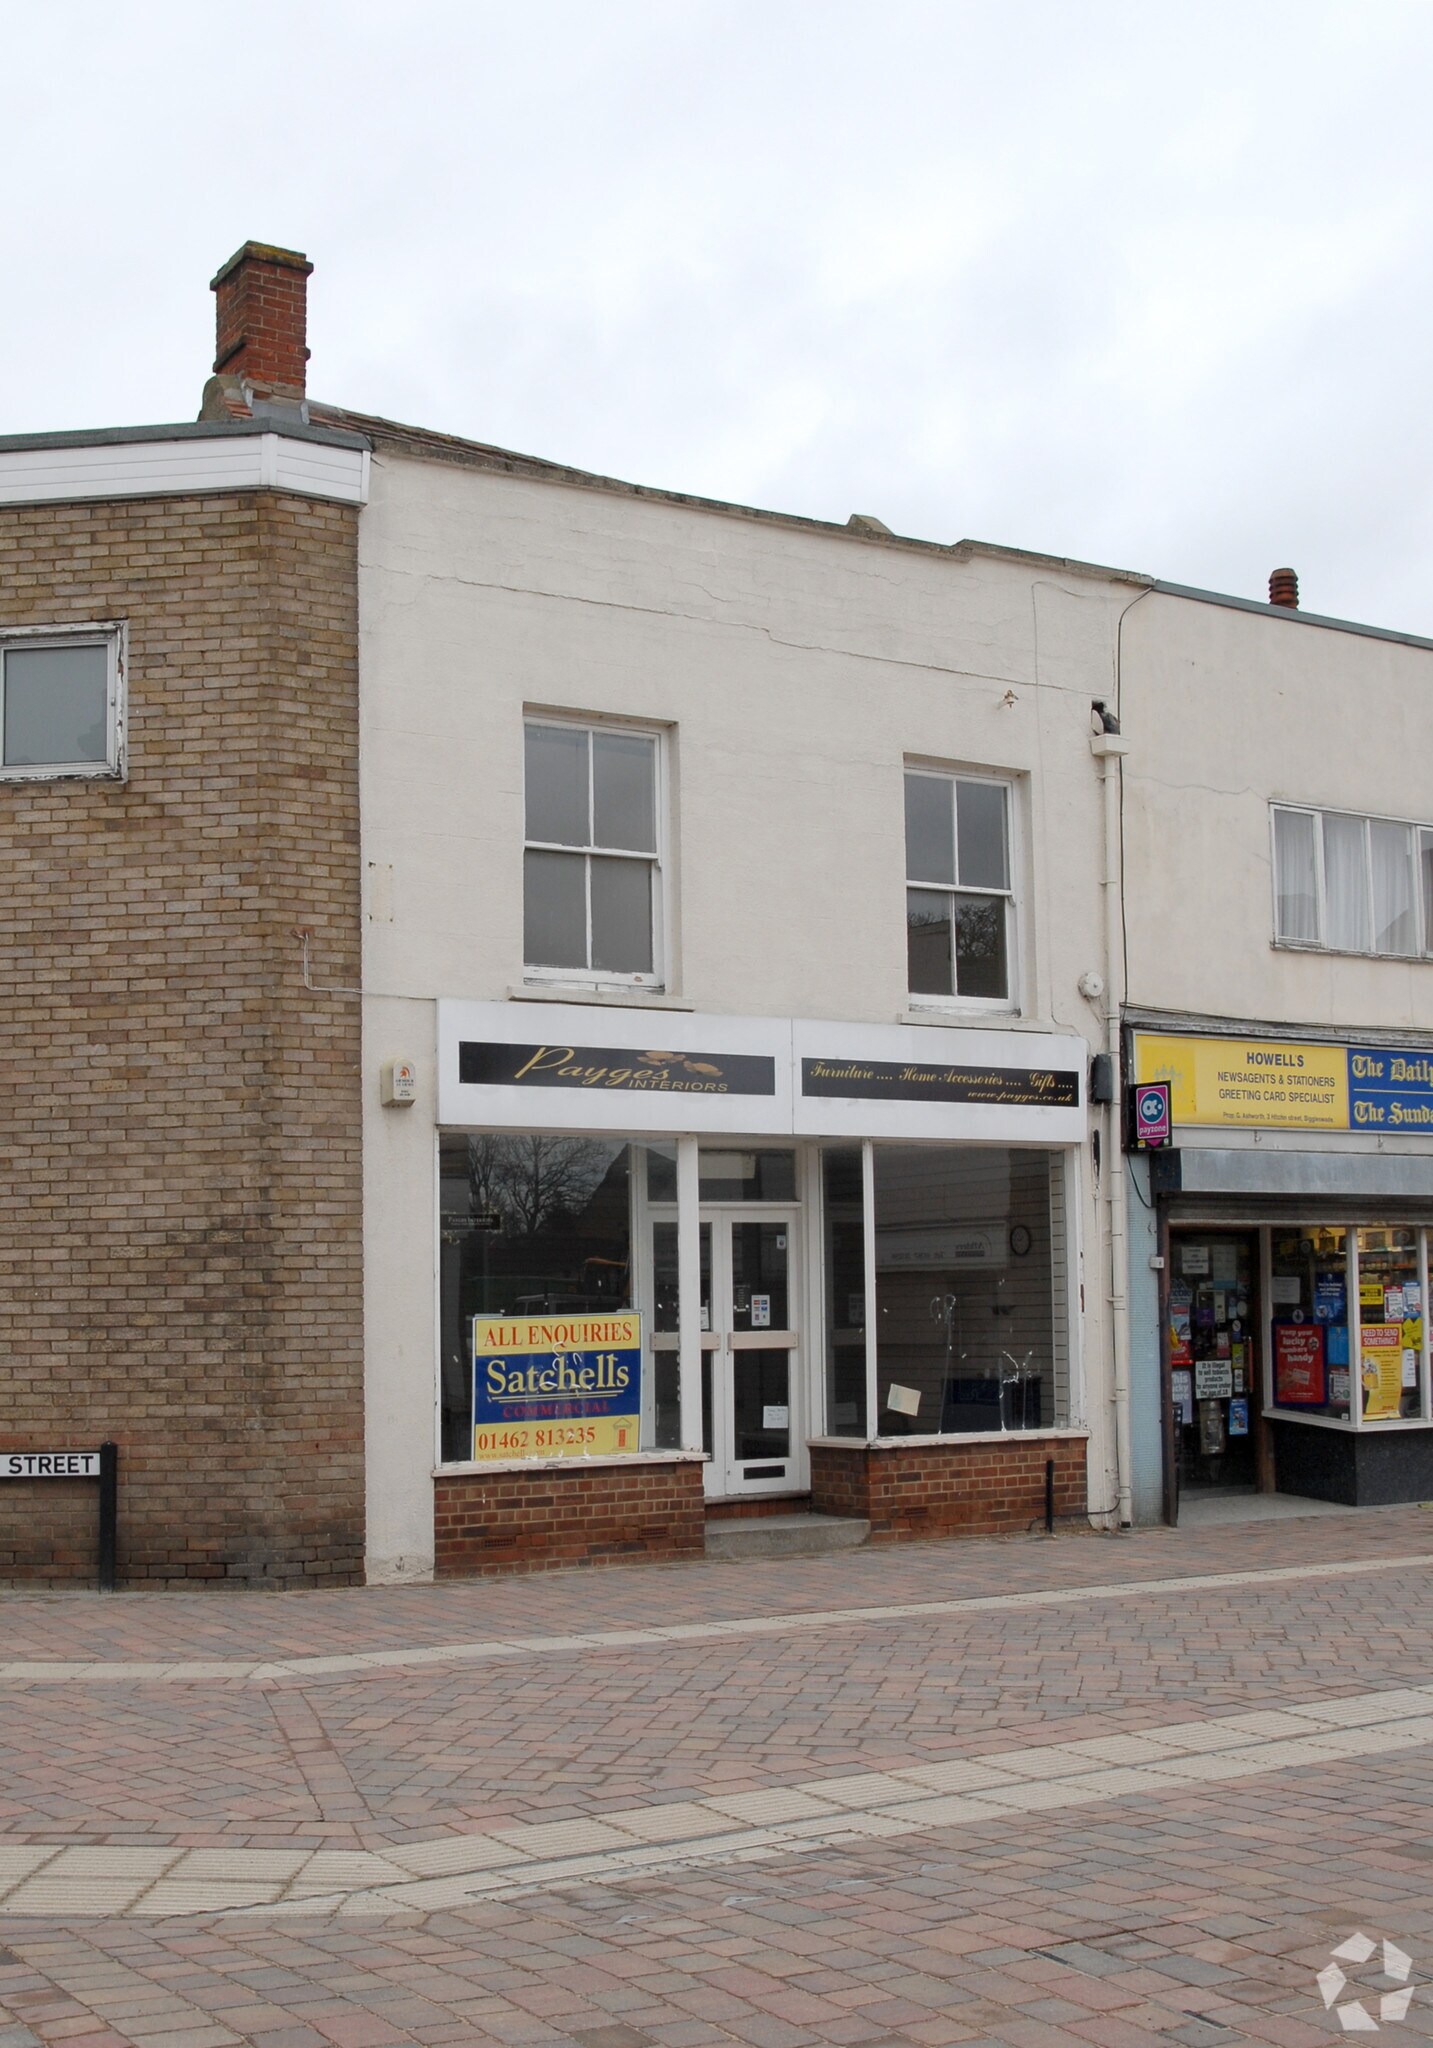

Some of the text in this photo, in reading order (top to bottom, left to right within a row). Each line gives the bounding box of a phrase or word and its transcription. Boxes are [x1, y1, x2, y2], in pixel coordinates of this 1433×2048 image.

[514, 1047, 670, 1086] Payges
[1246, 1052, 1305, 1067] HOWELL'S
[1352, 1054, 1384, 1079] The
[899, 1065, 937, 1082] Home
[1217, 1071, 1336, 1088] NEWSAGENTS & STATIONERS
[628, 1079, 729, 1093] INTERIORS
[1218, 1088, 1335, 1104] GREETING CARD SPECIALIST
[1354, 1100, 1385, 1124] The
[1140, 1126, 1167, 1136] payzone
[483, 1321, 633, 1348] ALL ENQUIRIES
[1362, 1328, 1376, 1337] NEED
[1376, 1328, 1383, 1337] TO
[1384, 1328, 1398, 1337] SEND
[1282, 1337, 1306, 1346] lucky
[1363, 1337, 1397, 1346] SOMETHING?
[1287, 1353, 1314, 1363] handy
[486, 1353, 630, 1394] Satchells
[478, 1427, 596, 1451] 01462 813235
[9, 1456, 94, 1474] STREET
